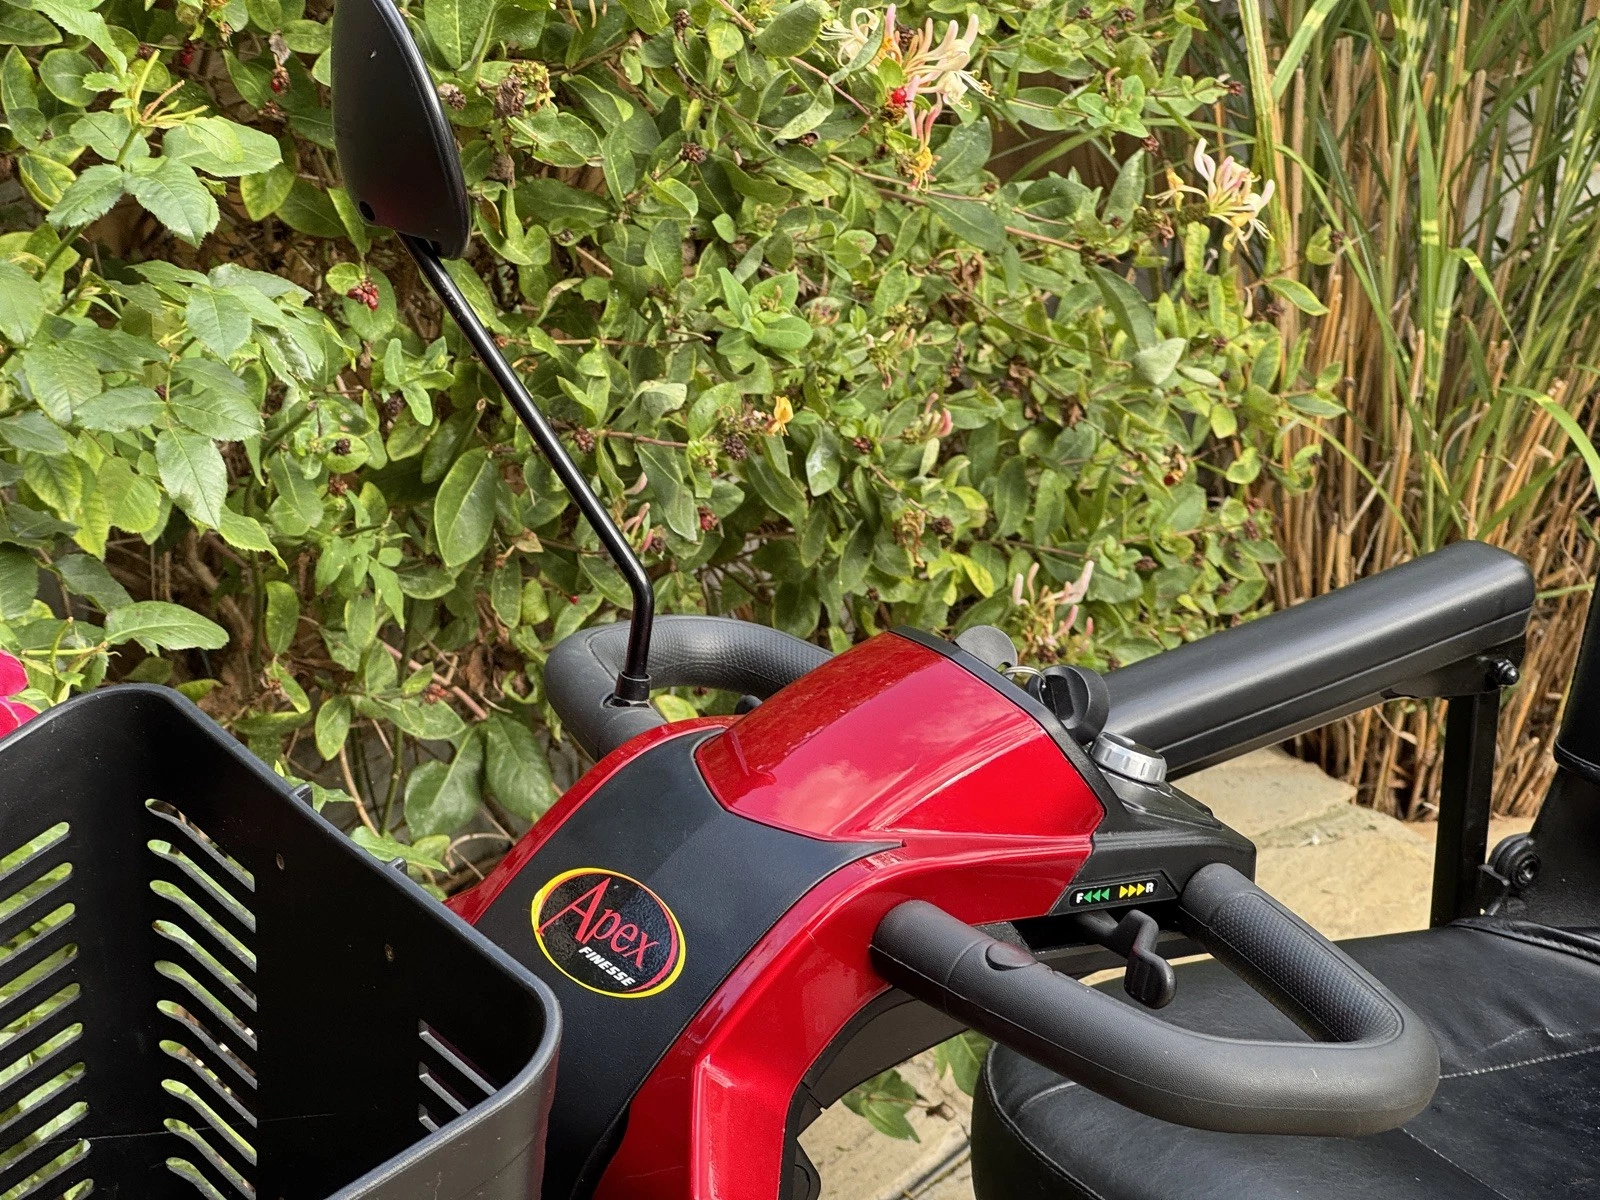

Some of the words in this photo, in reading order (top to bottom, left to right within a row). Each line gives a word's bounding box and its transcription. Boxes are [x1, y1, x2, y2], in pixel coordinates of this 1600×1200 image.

[1075, 892, 1084, 904] F
[1145, 882, 1154, 893] R
[536, 876, 660, 971] Apex
[578, 946, 636, 987] FINESSE
